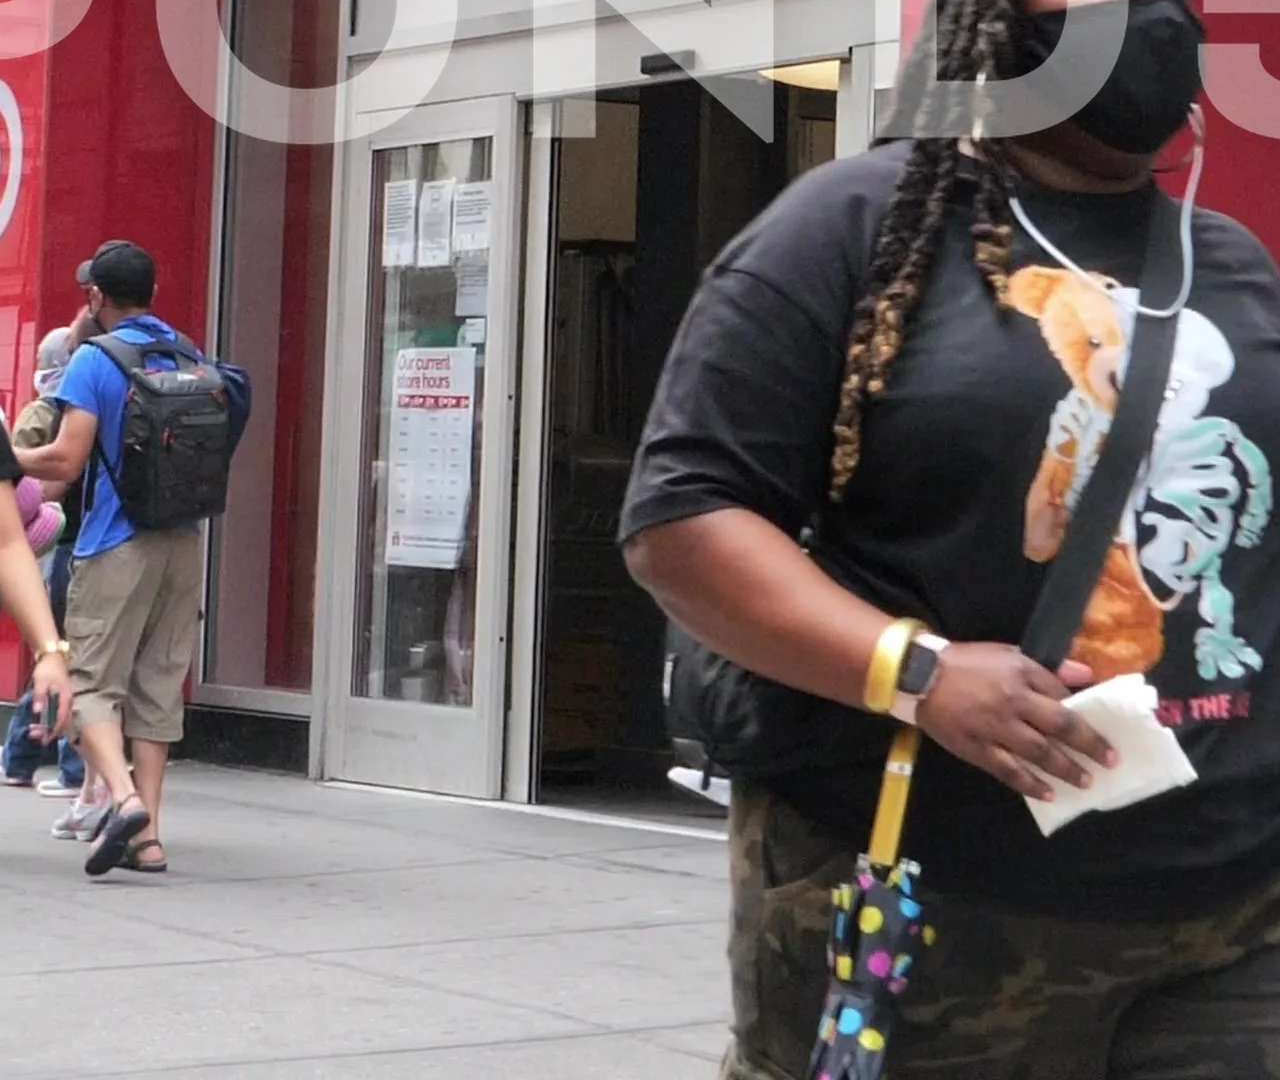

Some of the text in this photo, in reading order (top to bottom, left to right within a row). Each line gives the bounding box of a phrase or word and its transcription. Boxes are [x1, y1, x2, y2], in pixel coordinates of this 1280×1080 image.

[416, 353, 450, 370] current
[422, 372, 450, 389] hours
[1189, 693, 1232, 720] THE
